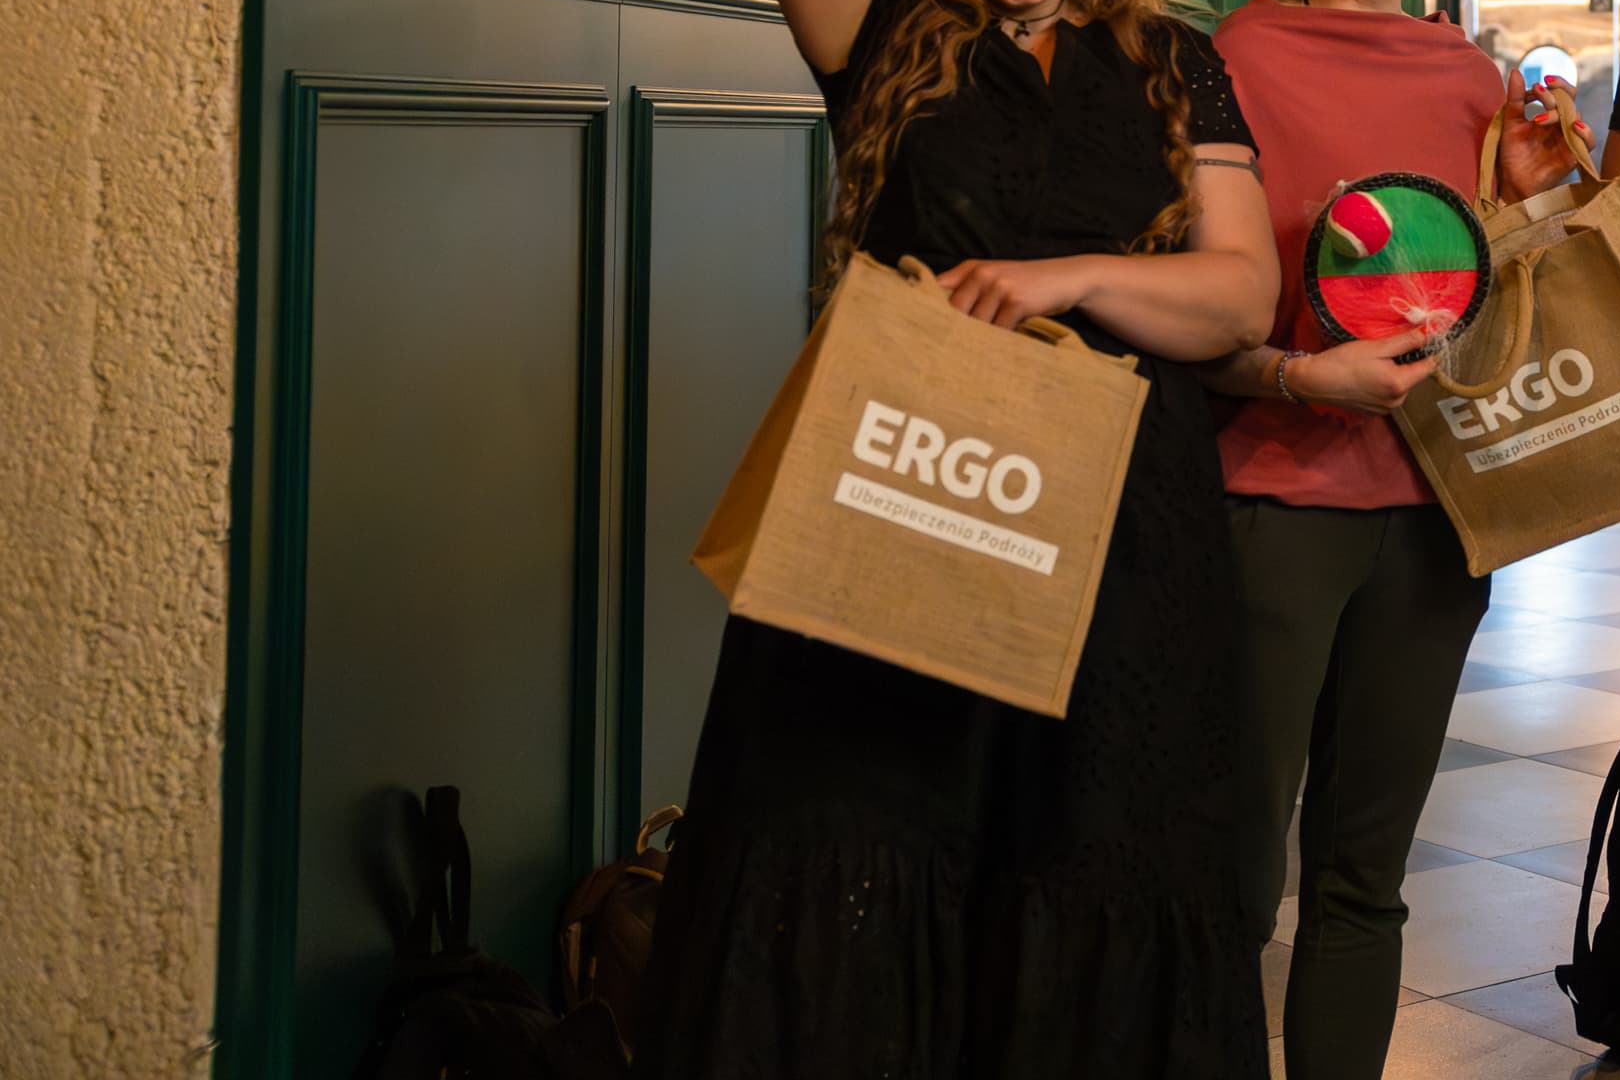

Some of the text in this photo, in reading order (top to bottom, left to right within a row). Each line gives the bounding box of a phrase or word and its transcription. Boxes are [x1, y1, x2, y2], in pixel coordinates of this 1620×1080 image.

[1437, 348, 1594, 440] ERGO
[852, 399, 1043, 514] ERGO
[1477, 423, 1576, 466] Ubezpieczenia
[850, 485, 1045, 565] Ubezpieczenia Podróży
